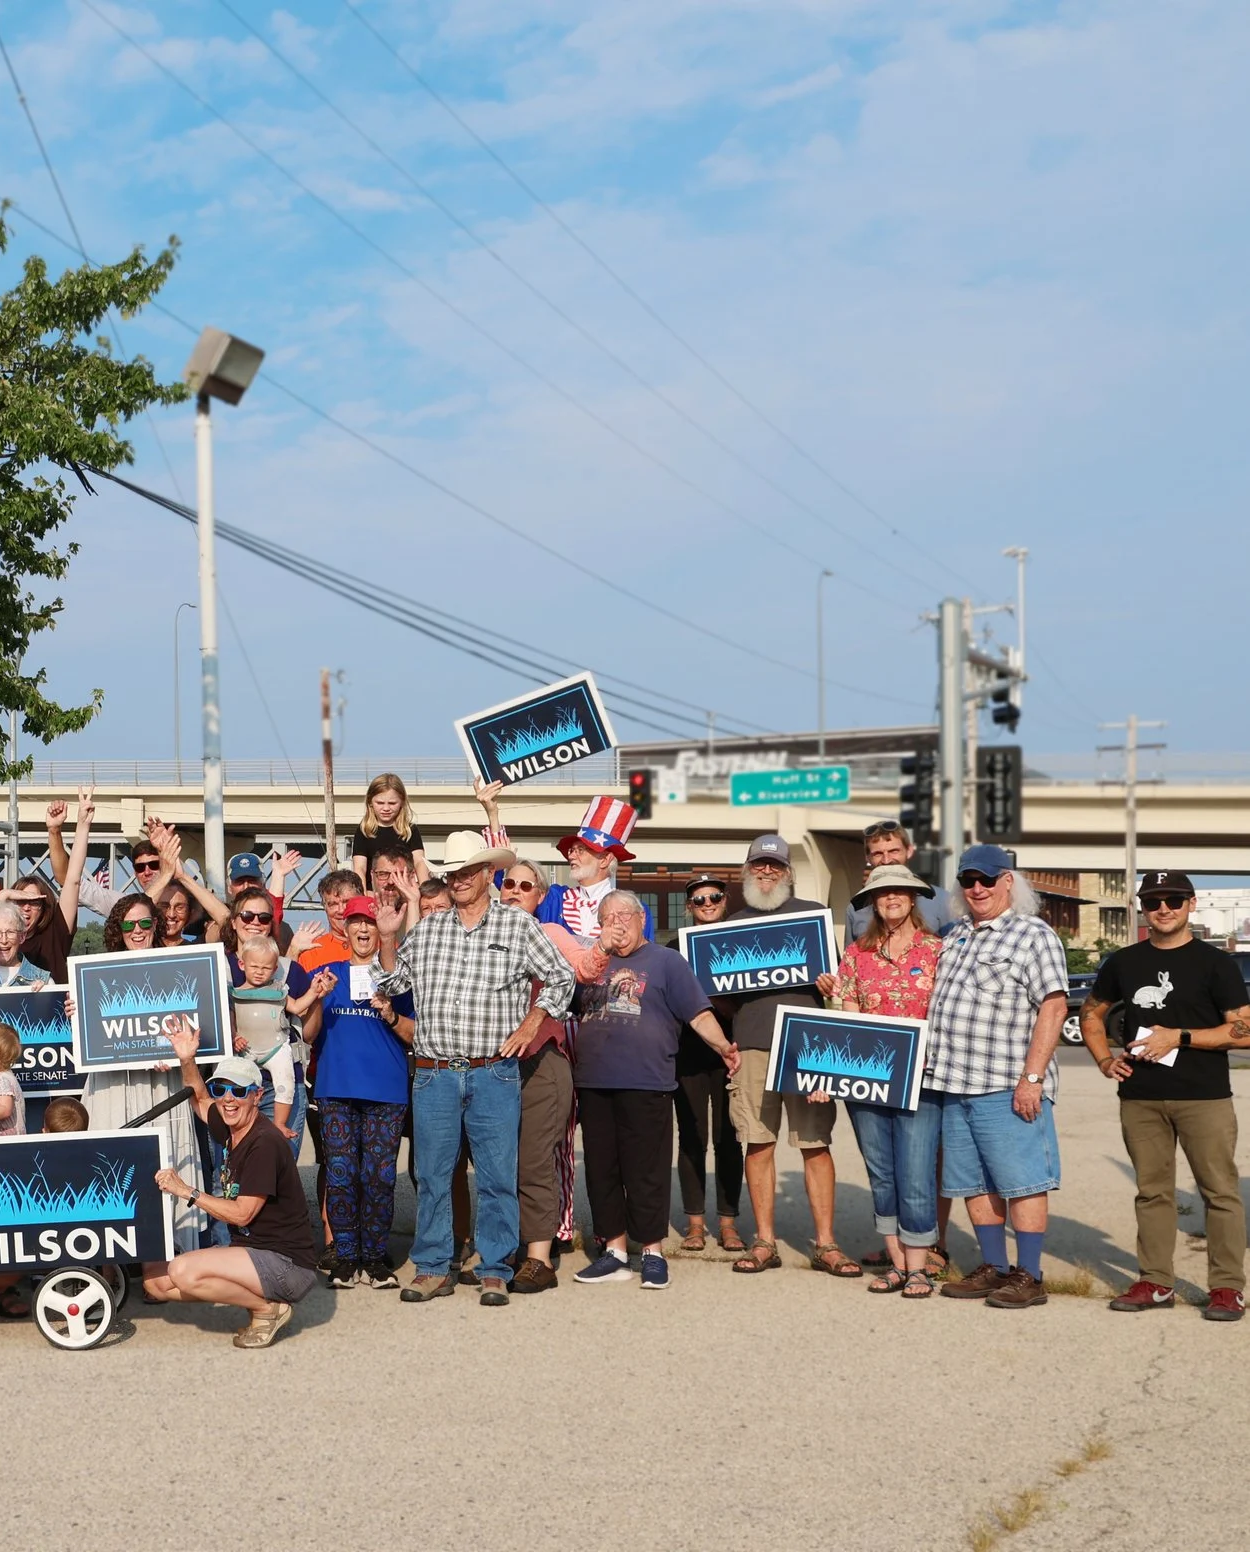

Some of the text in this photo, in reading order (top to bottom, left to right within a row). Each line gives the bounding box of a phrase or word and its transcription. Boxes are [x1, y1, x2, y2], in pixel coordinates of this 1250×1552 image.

[502, 737, 591, 782] WILSON
[1156, 872, 1168, 884] F
[712, 966, 809, 992] WILSON
[331, 1007, 384, 1020] VOLLEYBAL
[102, 1012, 200, 1039] WILSON
[113, 1041, 129, 1050] MN
[131, 1038, 156, 1049] STATE
[15, 1071, 68, 1082] ATE SENATE
[796, 1072, 890, 1103] WILSON
